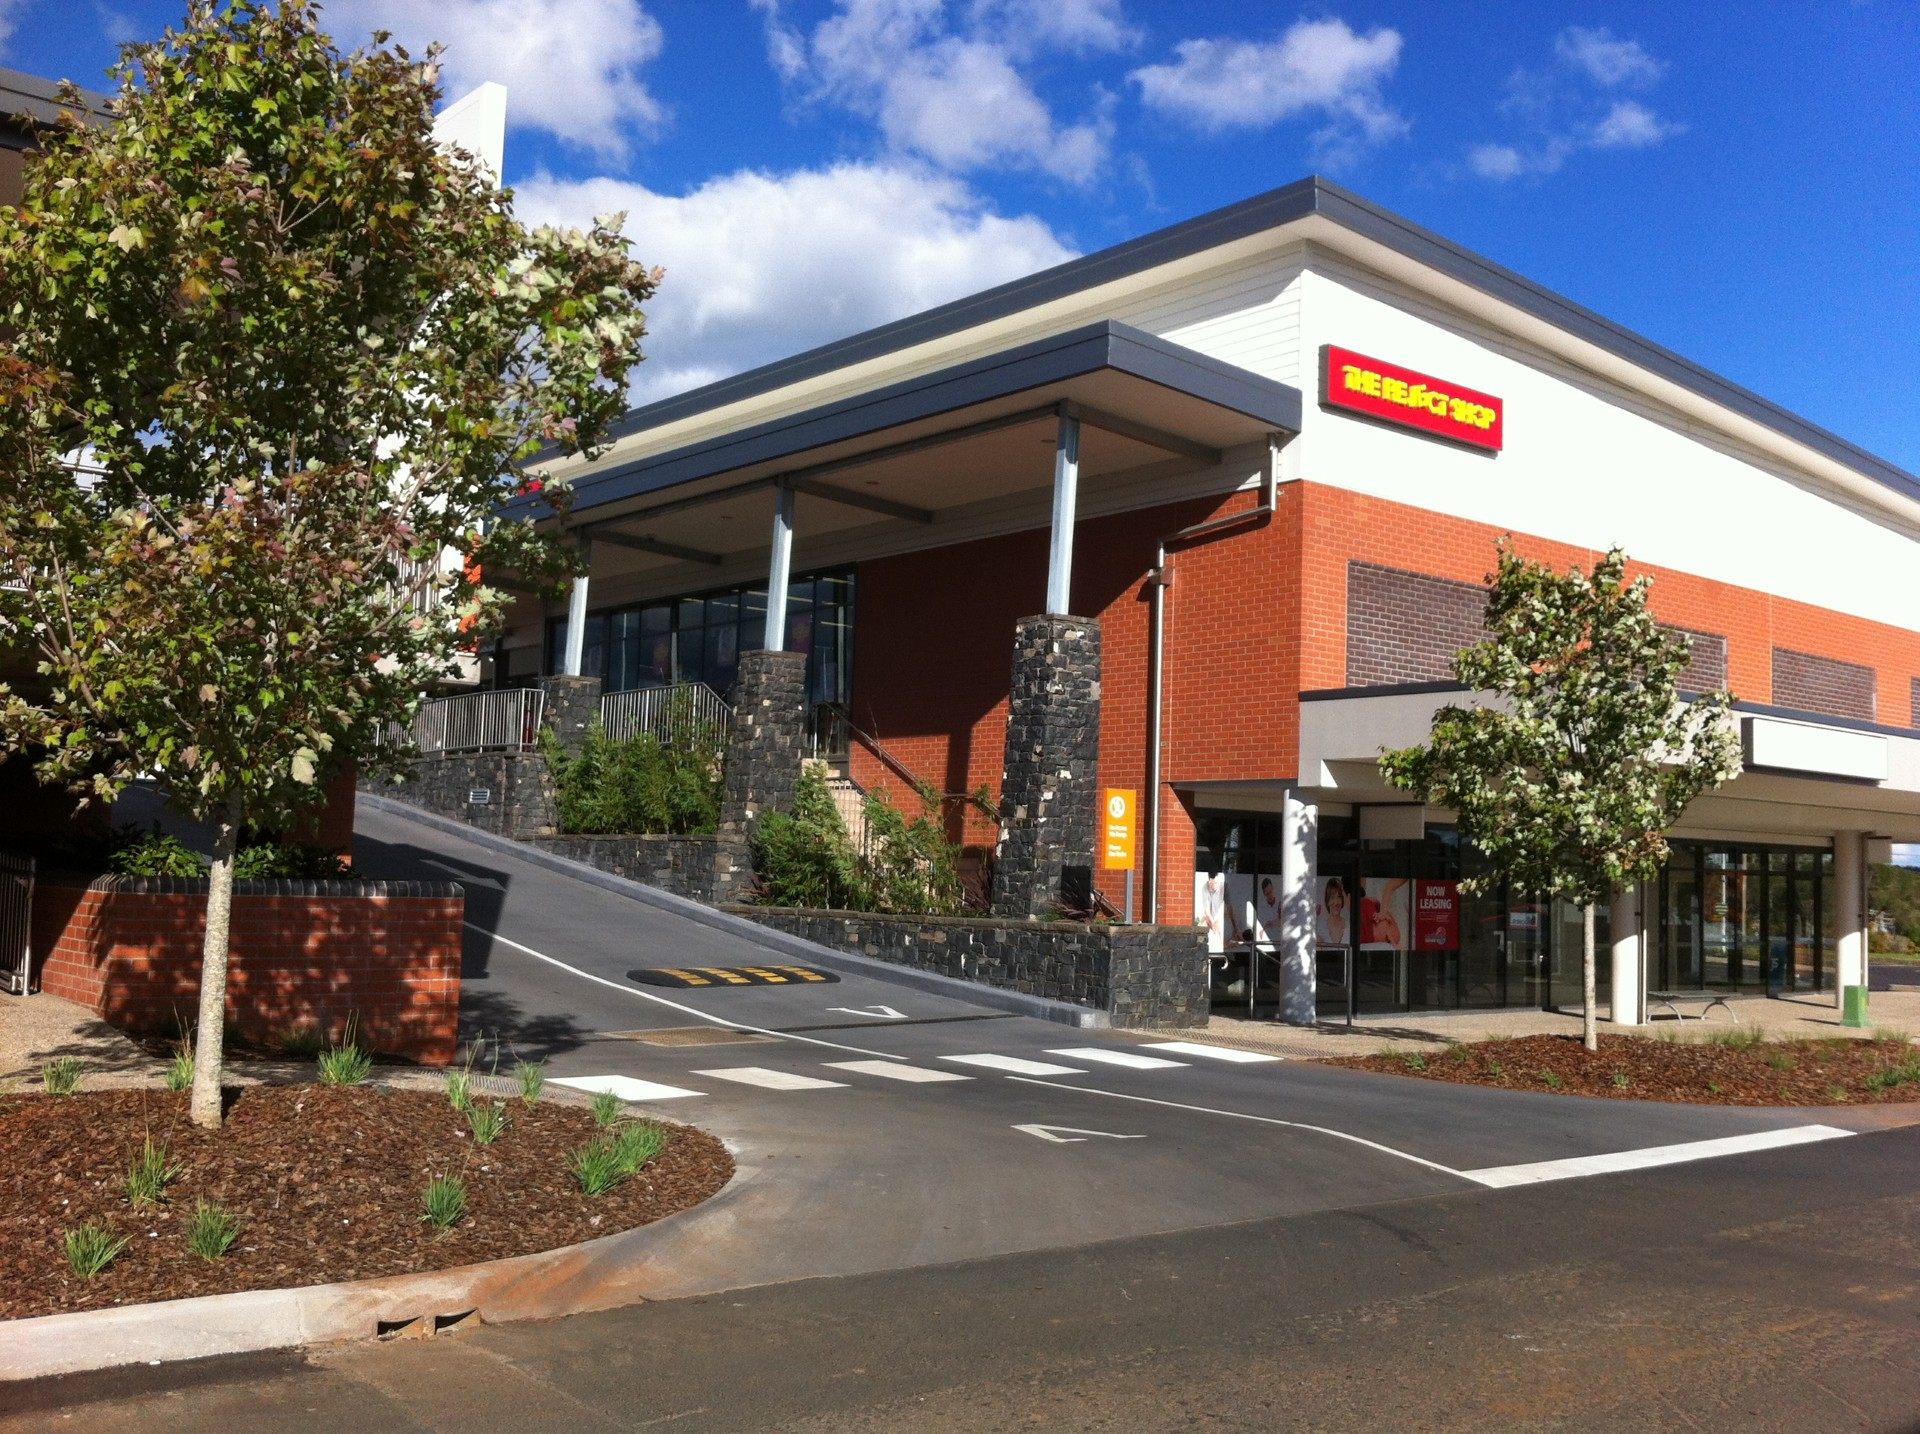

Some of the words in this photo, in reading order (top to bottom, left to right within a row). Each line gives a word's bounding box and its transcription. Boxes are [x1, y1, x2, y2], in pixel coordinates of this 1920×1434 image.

[1342, 365, 1382, 397] THE
[1449, 398, 1496, 430] SHOP
[1426, 886, 1445, 896] NOW
[1420, 899, 1452, 909] LEASING
